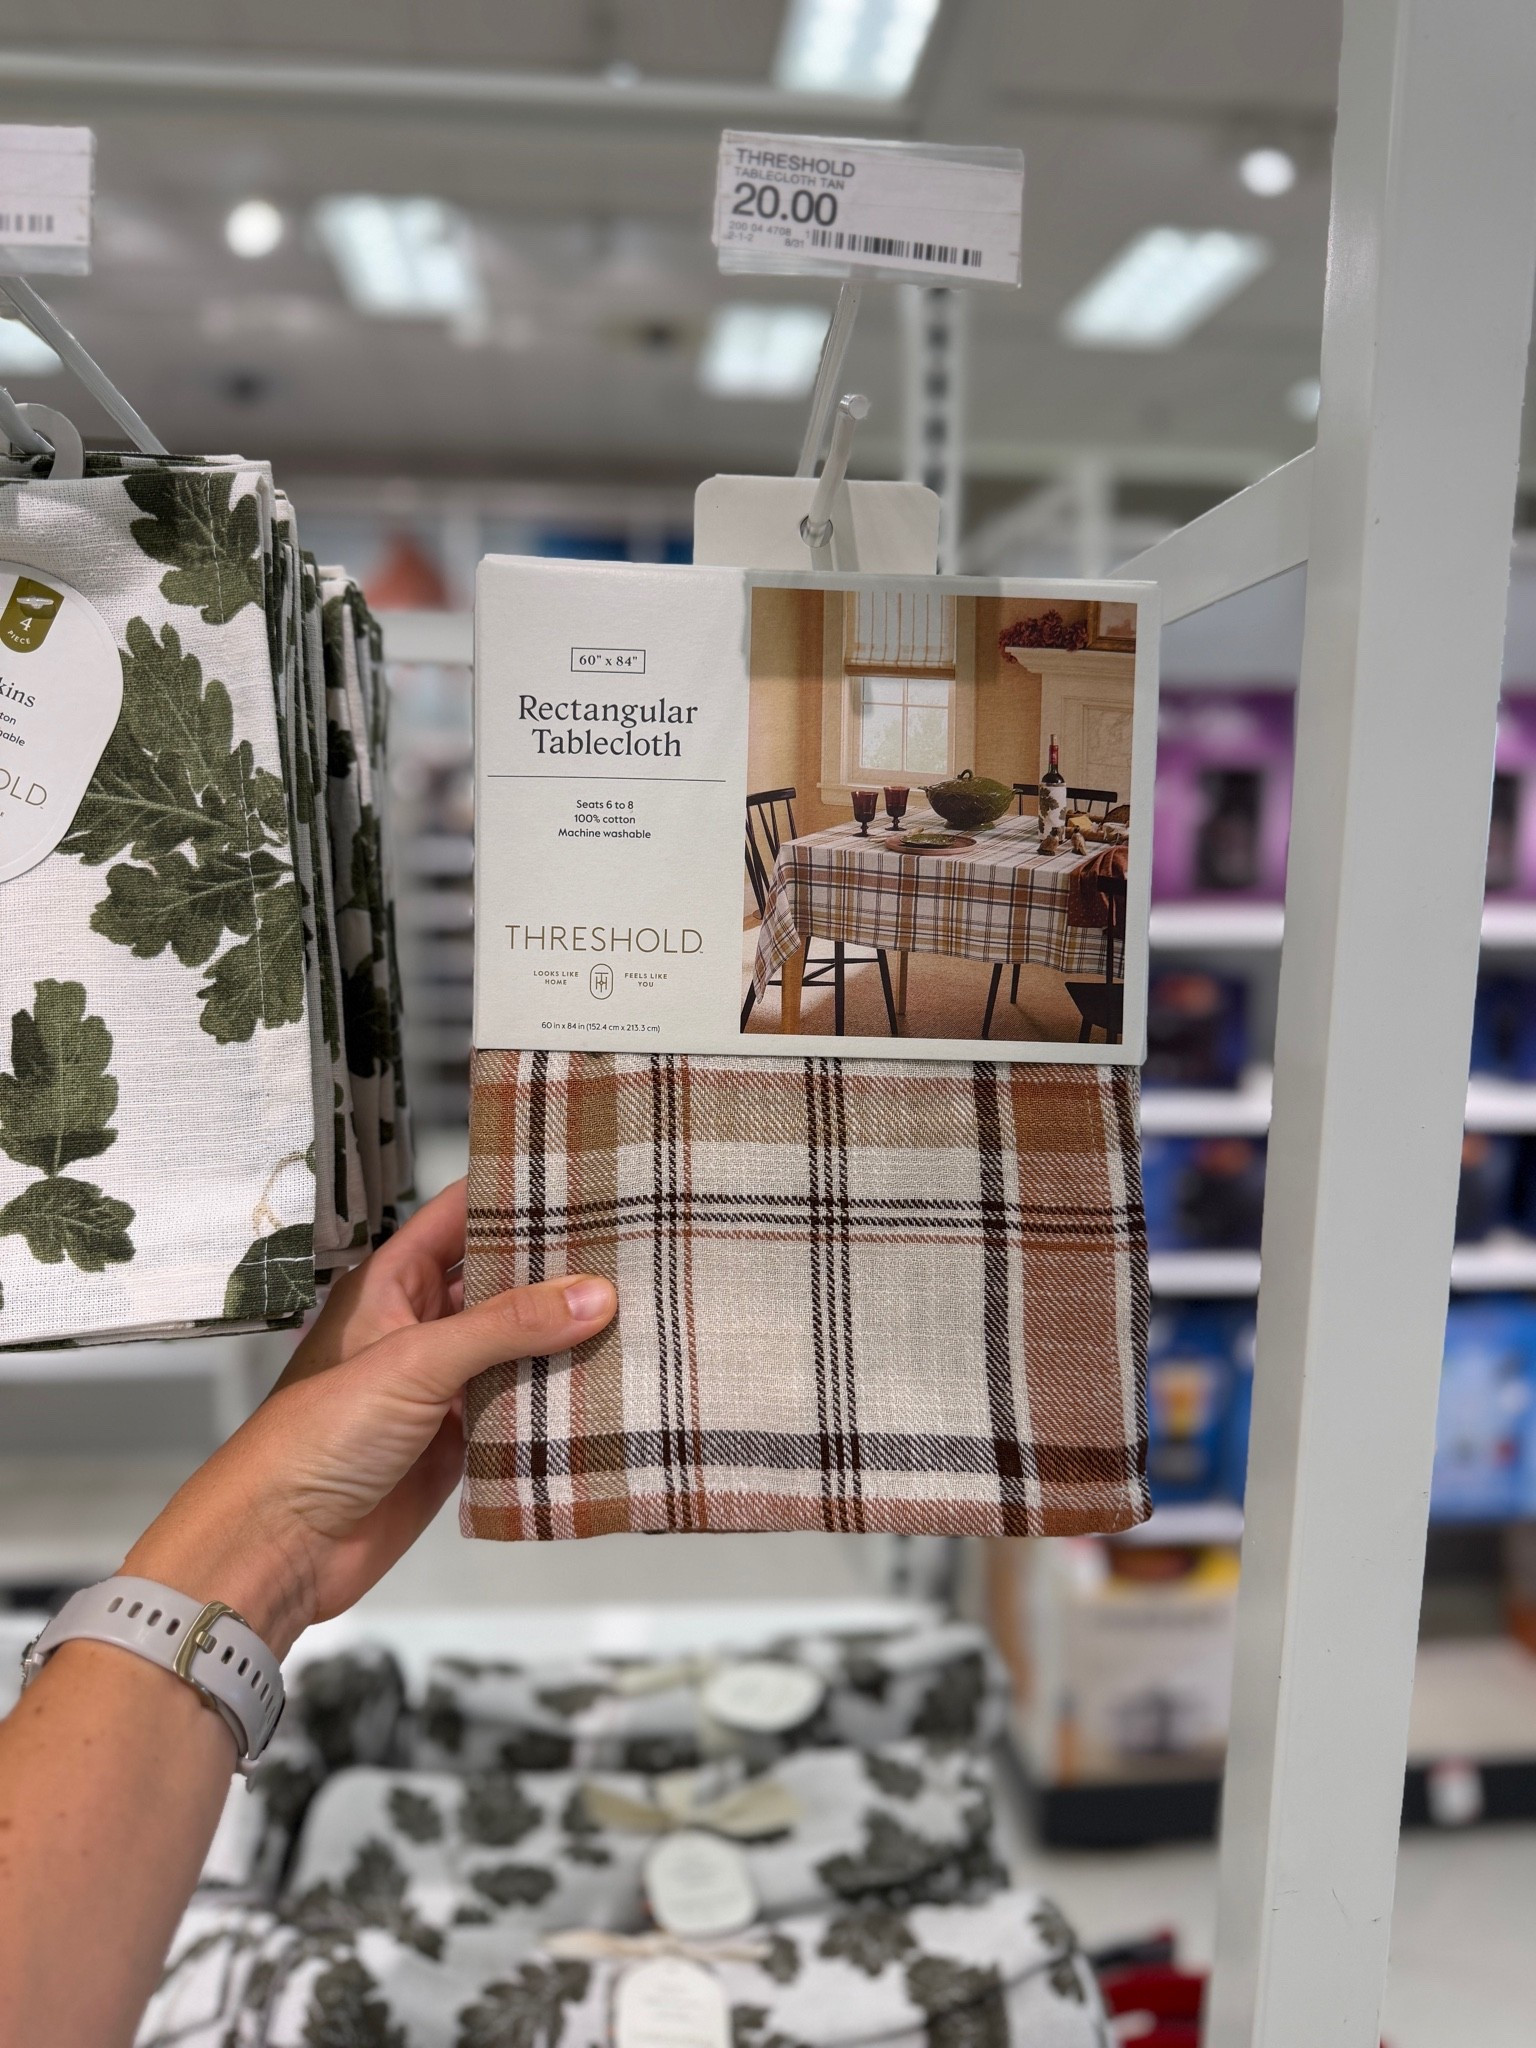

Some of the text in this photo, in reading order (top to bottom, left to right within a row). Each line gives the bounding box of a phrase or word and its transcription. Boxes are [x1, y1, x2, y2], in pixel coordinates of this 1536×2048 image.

[736, 148, 855, 178] THRESHOLD
[734, 166, 845, 191] TABLECLOTH TAN
[731, 182, 838, 227] 20.00
[19, 617, 33, 632] 4
[7, 629, 31, 645] PIECE
[605, 657, 613, 667] x
[518, 694, 699, 728] Rectangular
[531, 728, 682, 757] Tablecloth
[576, 799, 634, 810] Seats 6 to 8
[574, 813, 636, 825] 100% cotton
[558, 828, 652, 839] Machine washable
[541, 1021, 553, 1029] 60
[567, 1022, 577, 1030] 84
[578, 1022, 585, 1030] in
[586, 1023, 607, 1032] (152.4
[626, 1024, 646, 1032] 213.3
[647, 1025, 661, 1034] cm)
